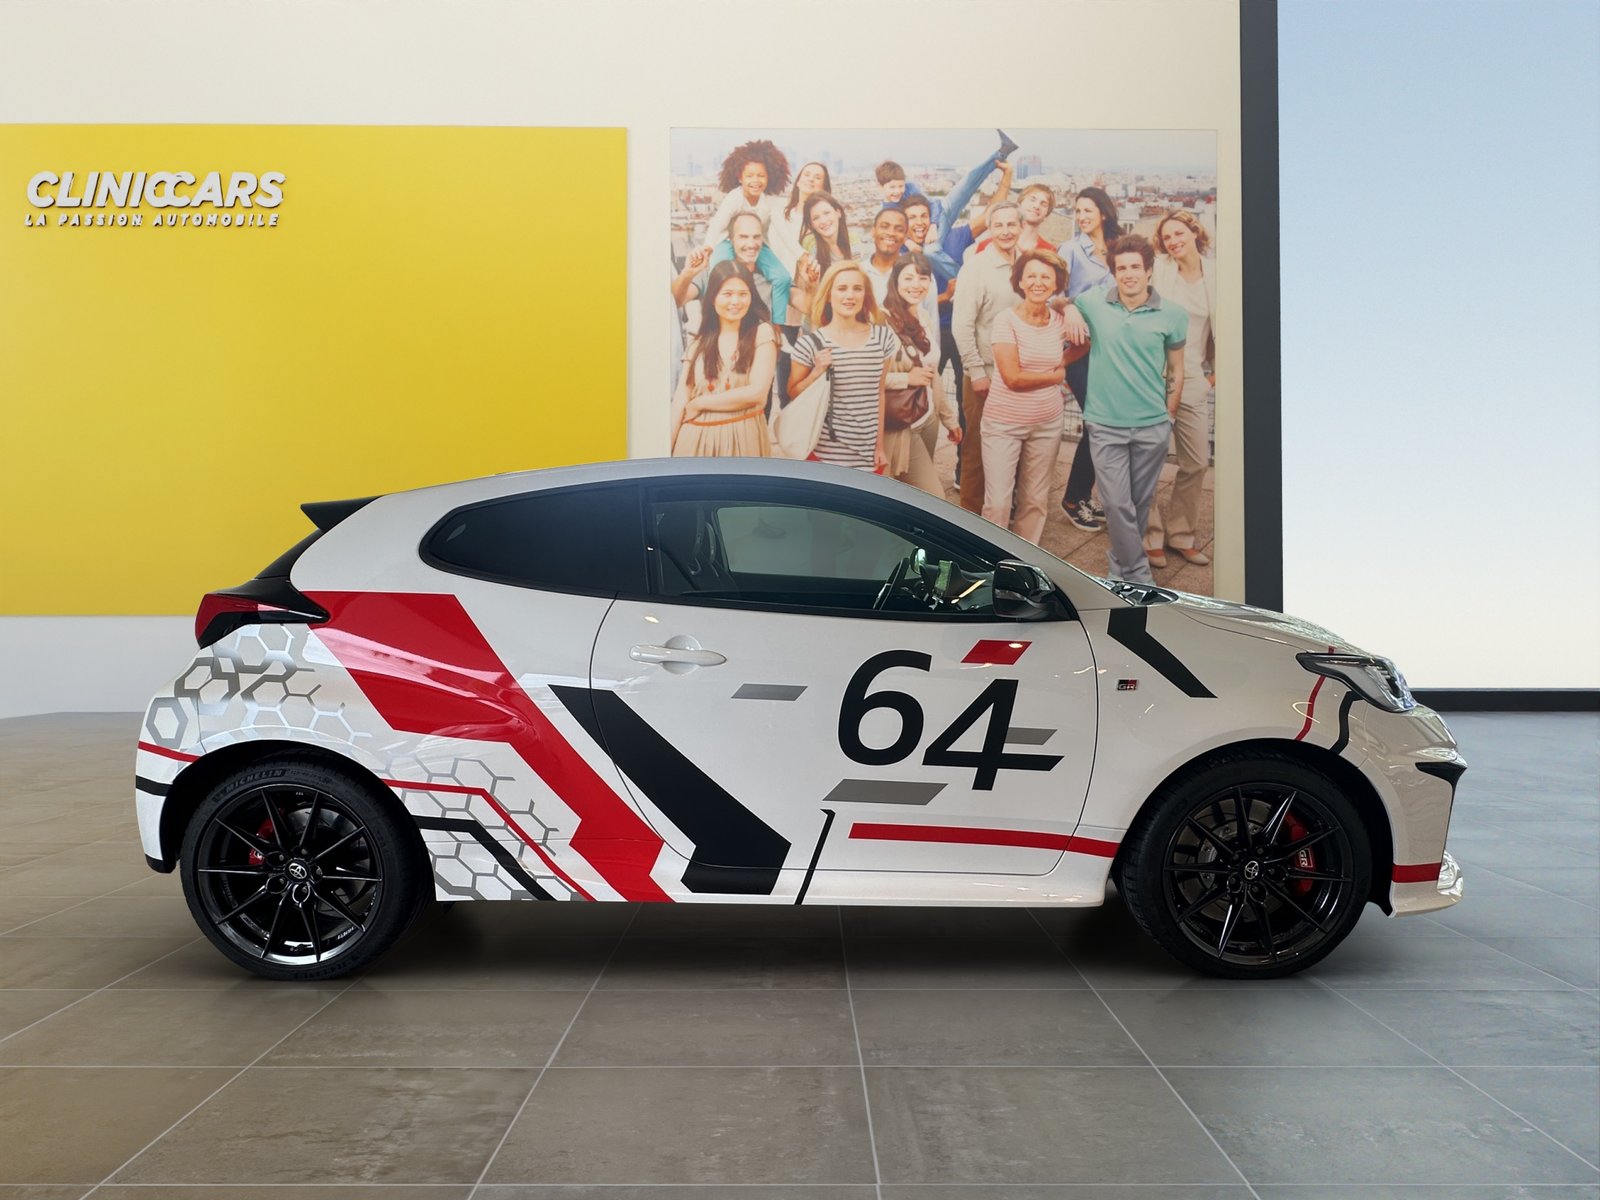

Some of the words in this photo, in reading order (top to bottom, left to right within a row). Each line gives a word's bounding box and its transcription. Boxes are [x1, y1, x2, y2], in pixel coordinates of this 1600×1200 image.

[24, 214, 47, 227] LA
[58, 214, 143, 227] PASSION
[153, 214, 280, 227] AUTOMOBILE
[838, 649, 1064, 790] 64
[225, 769, 284, 793] MICHELIN
